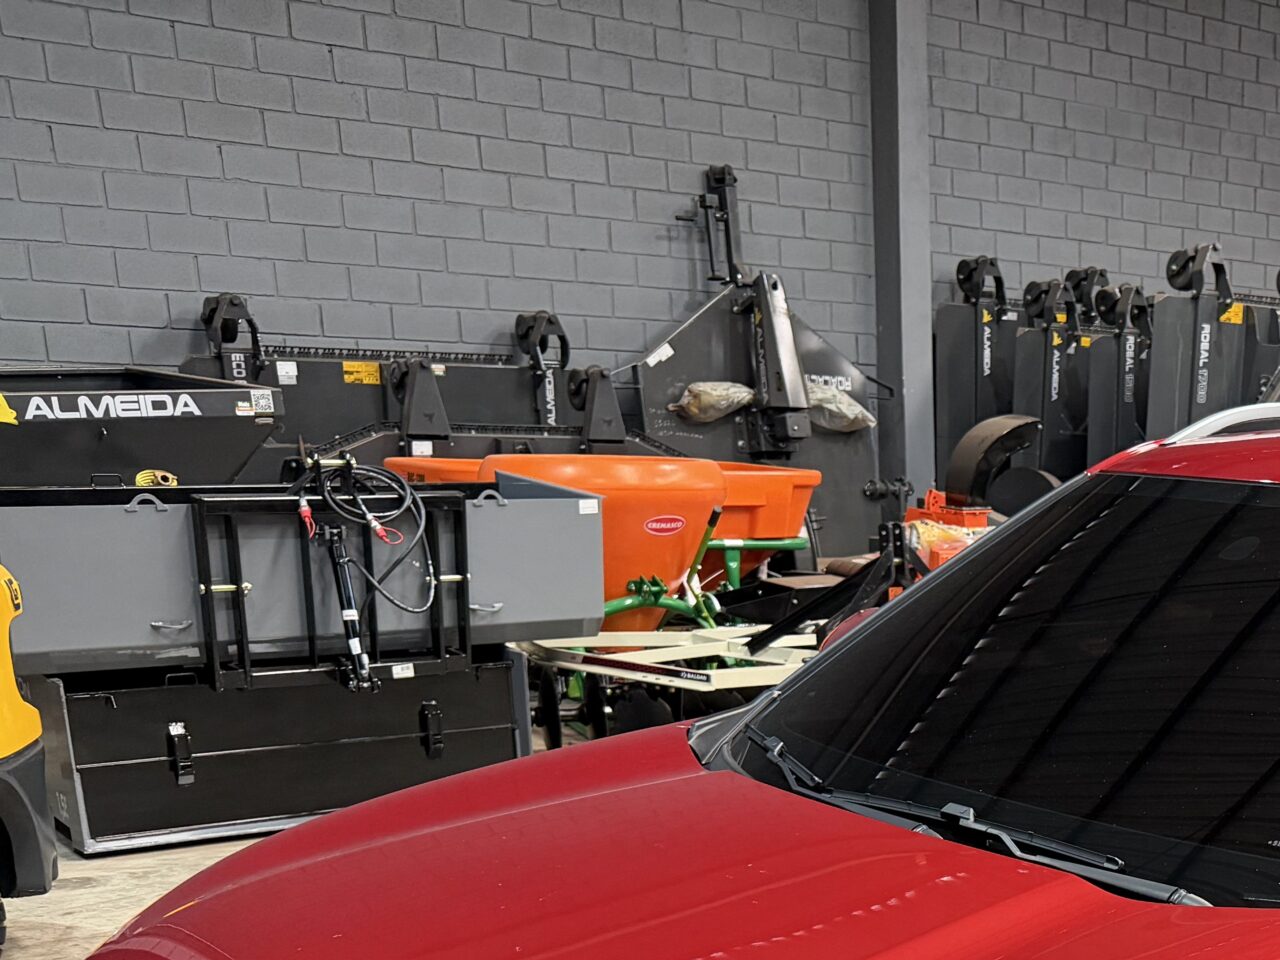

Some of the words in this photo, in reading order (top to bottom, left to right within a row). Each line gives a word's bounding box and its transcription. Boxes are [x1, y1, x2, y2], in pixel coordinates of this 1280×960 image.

[231, 353, 247, 378] ECO
[24, 393, 202, 420] ALMEIDA
[545, 368, 557, 426] ALMEIDA
